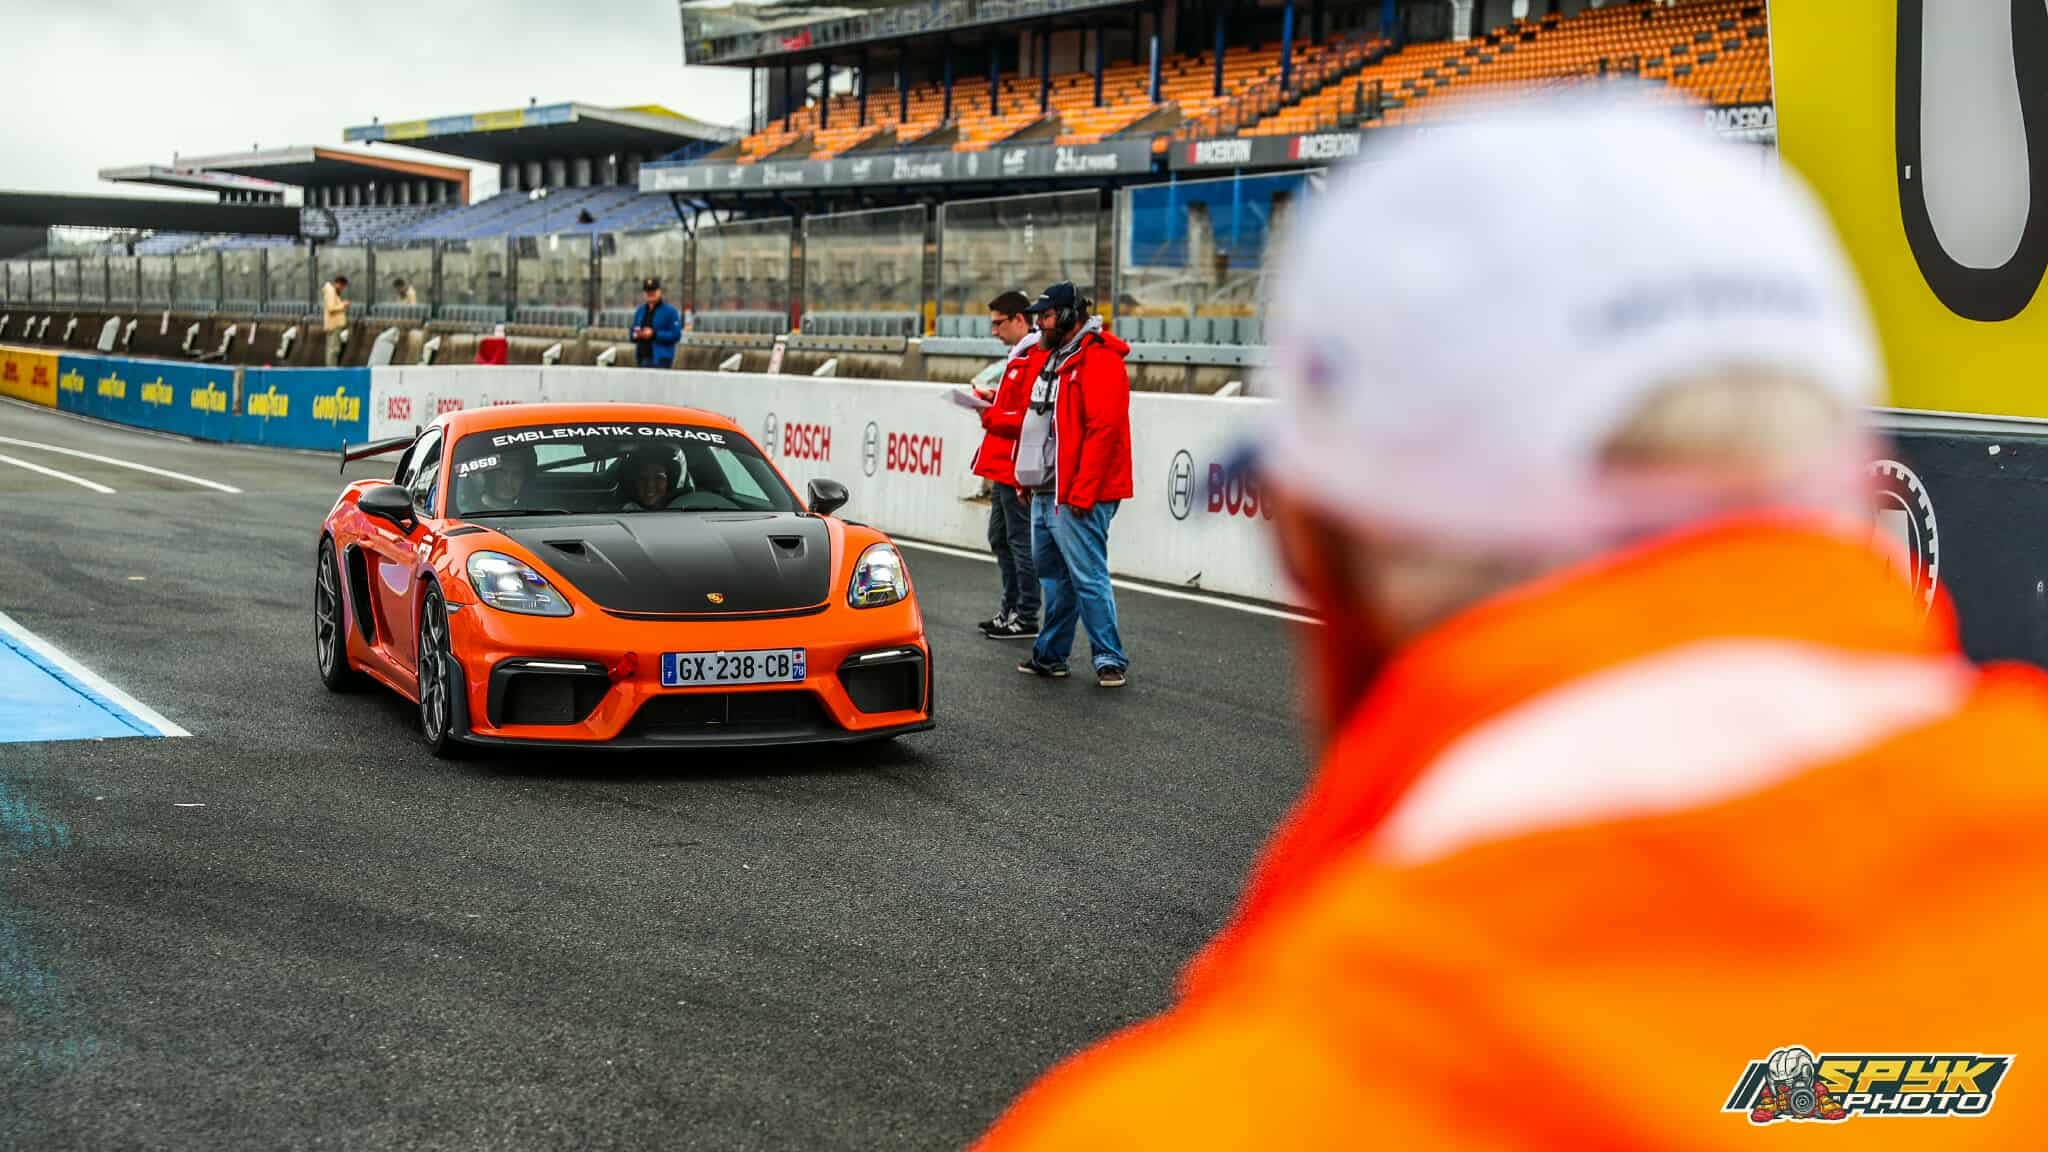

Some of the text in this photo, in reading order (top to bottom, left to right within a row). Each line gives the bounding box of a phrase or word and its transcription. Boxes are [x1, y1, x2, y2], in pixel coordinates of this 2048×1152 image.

[492, 426, 726, 447] EMBLEMATIK GARAGE
[783, 422, 831, 462] BOSCH
[886, 431, 943, 477] BOSCH
[679, 654, 789, 681] GX-238-CB
